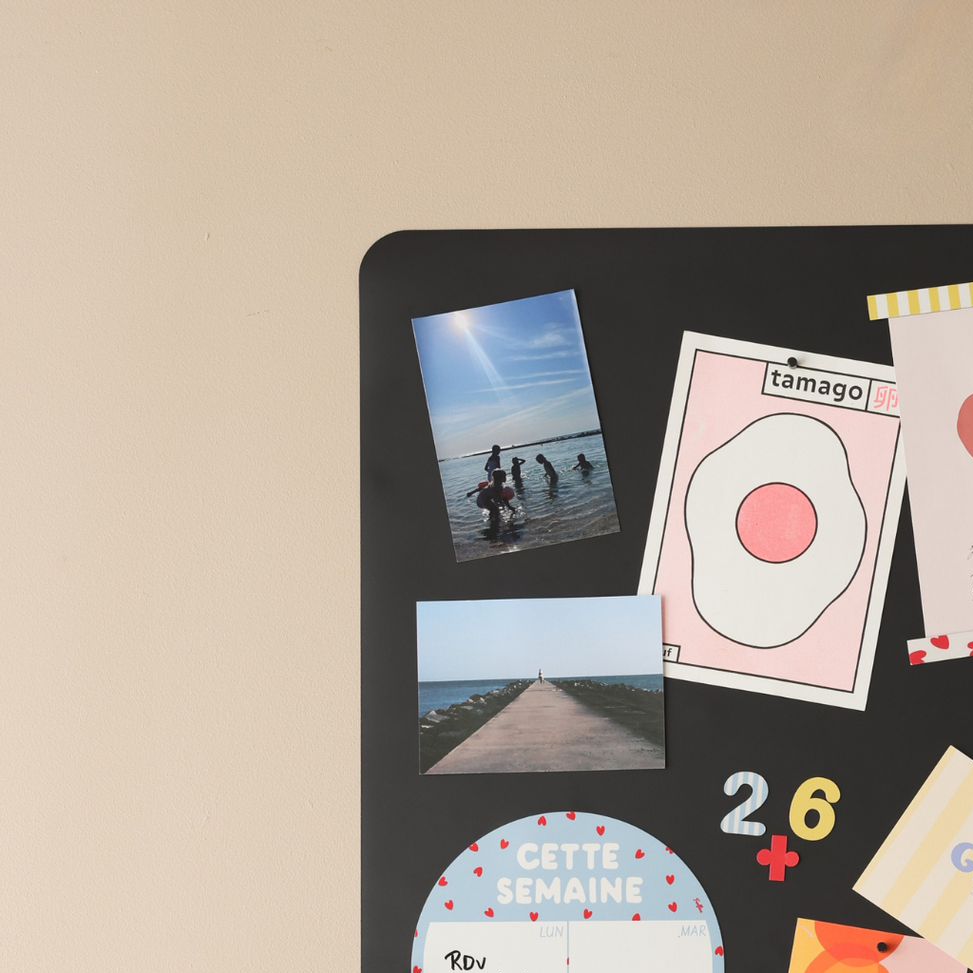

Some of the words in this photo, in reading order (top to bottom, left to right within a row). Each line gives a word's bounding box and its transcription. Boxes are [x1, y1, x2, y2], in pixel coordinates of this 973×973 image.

[771, 369, 863, 403] tamago
[517, 842, 620, 870] CETTE
[496, 877, 643, 905] SEMAINE
[540, 926, 564, 938] LUN
[680, 925, 706, 937] MAR
